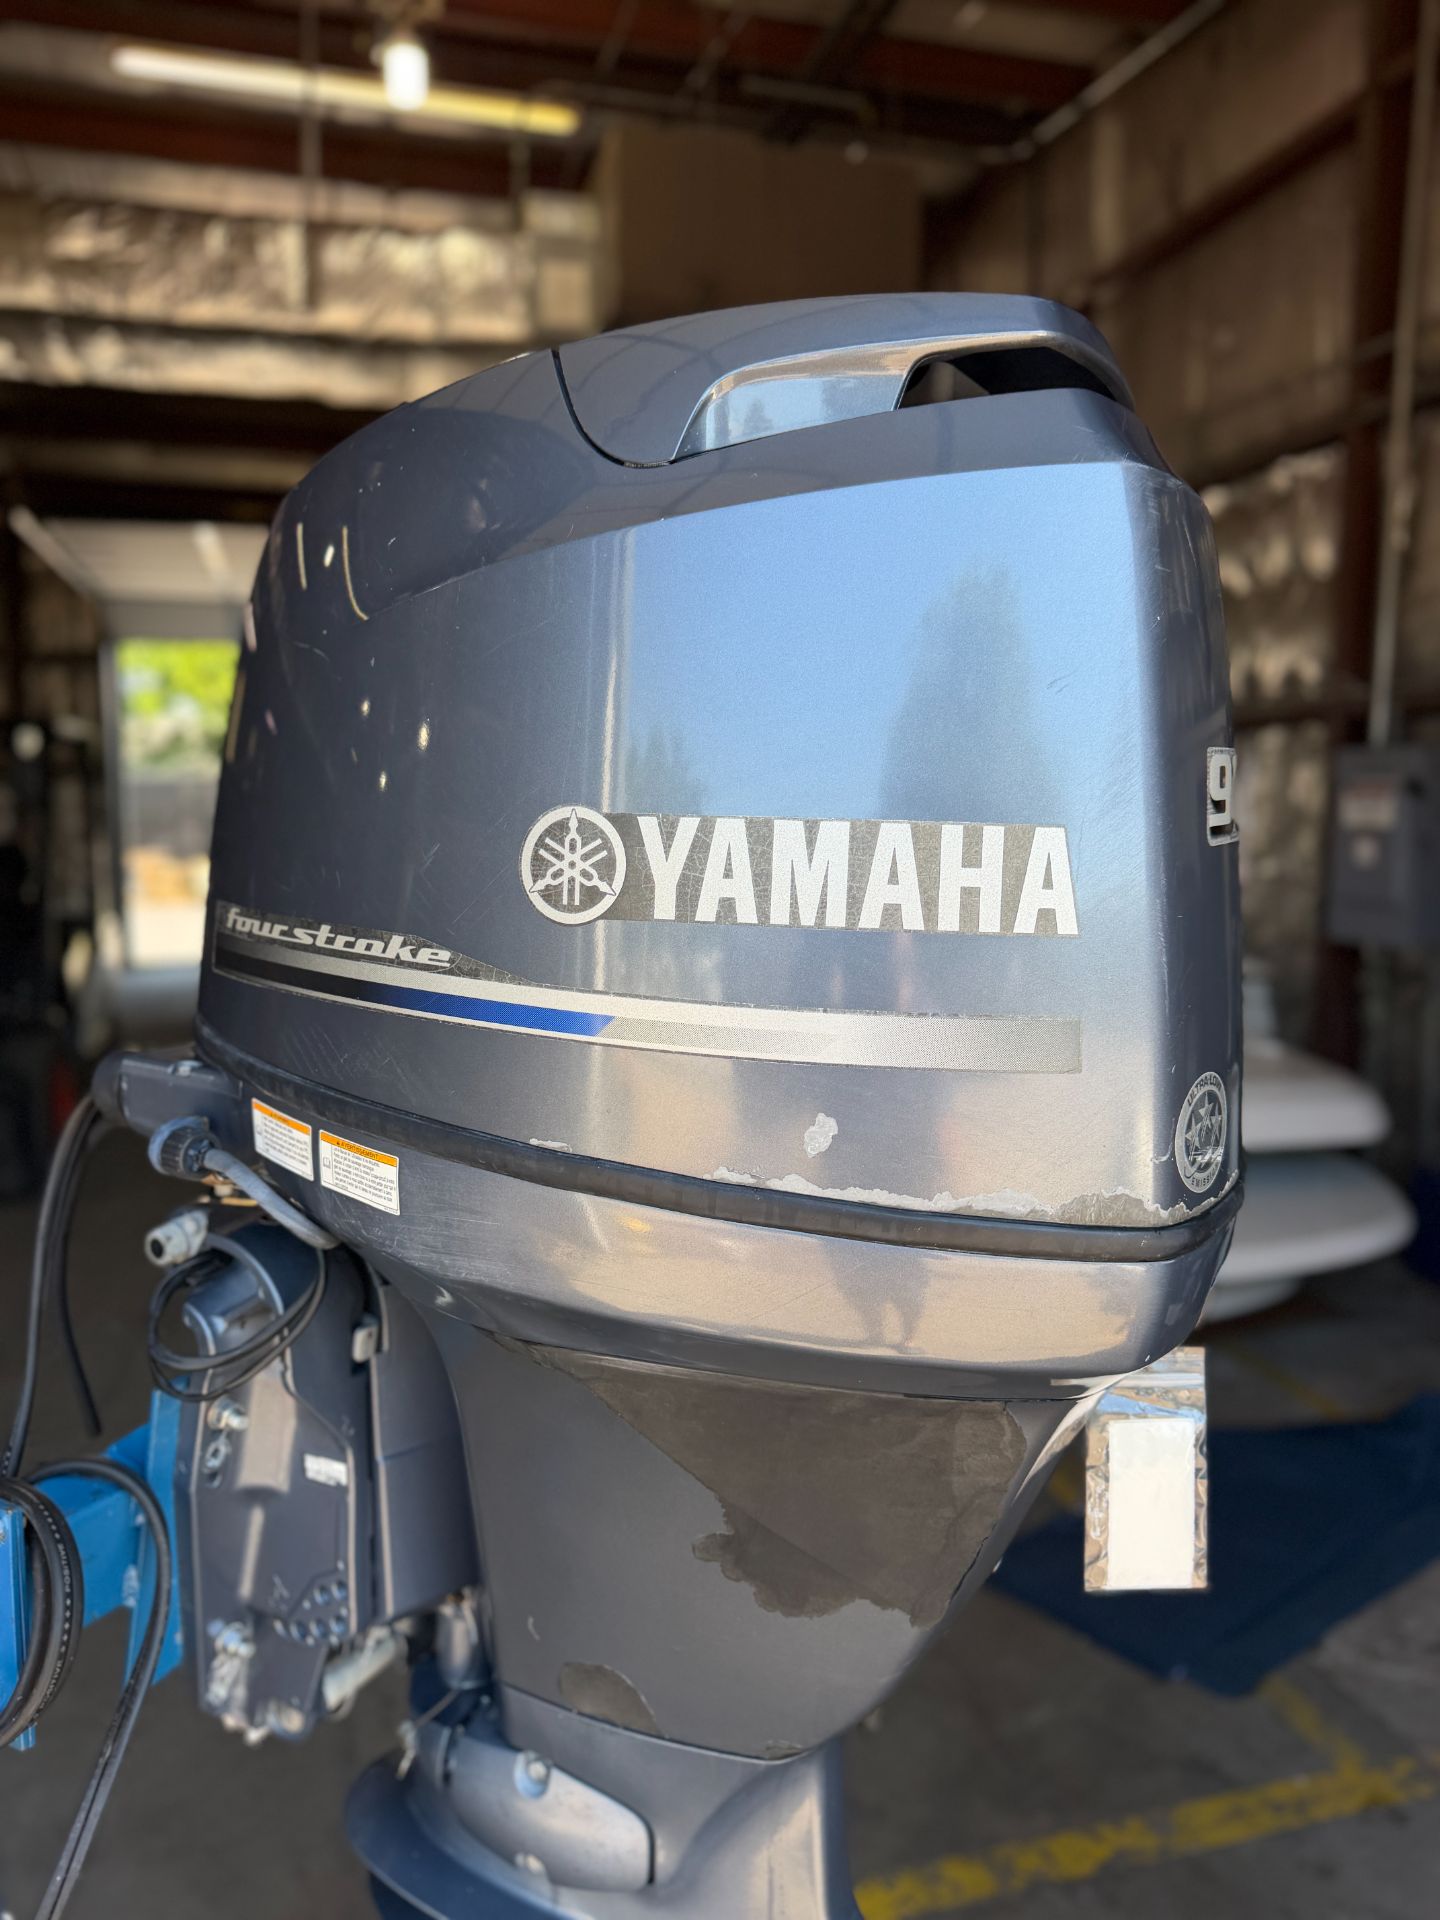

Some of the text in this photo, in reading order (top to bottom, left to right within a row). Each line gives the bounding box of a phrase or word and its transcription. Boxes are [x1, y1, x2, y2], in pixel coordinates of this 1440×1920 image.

[1209, 753, 1238, 826] 9
[636, 815, 1080, 935] YAMAHA
[57, 1542, 72, 1593] POSITIVE
